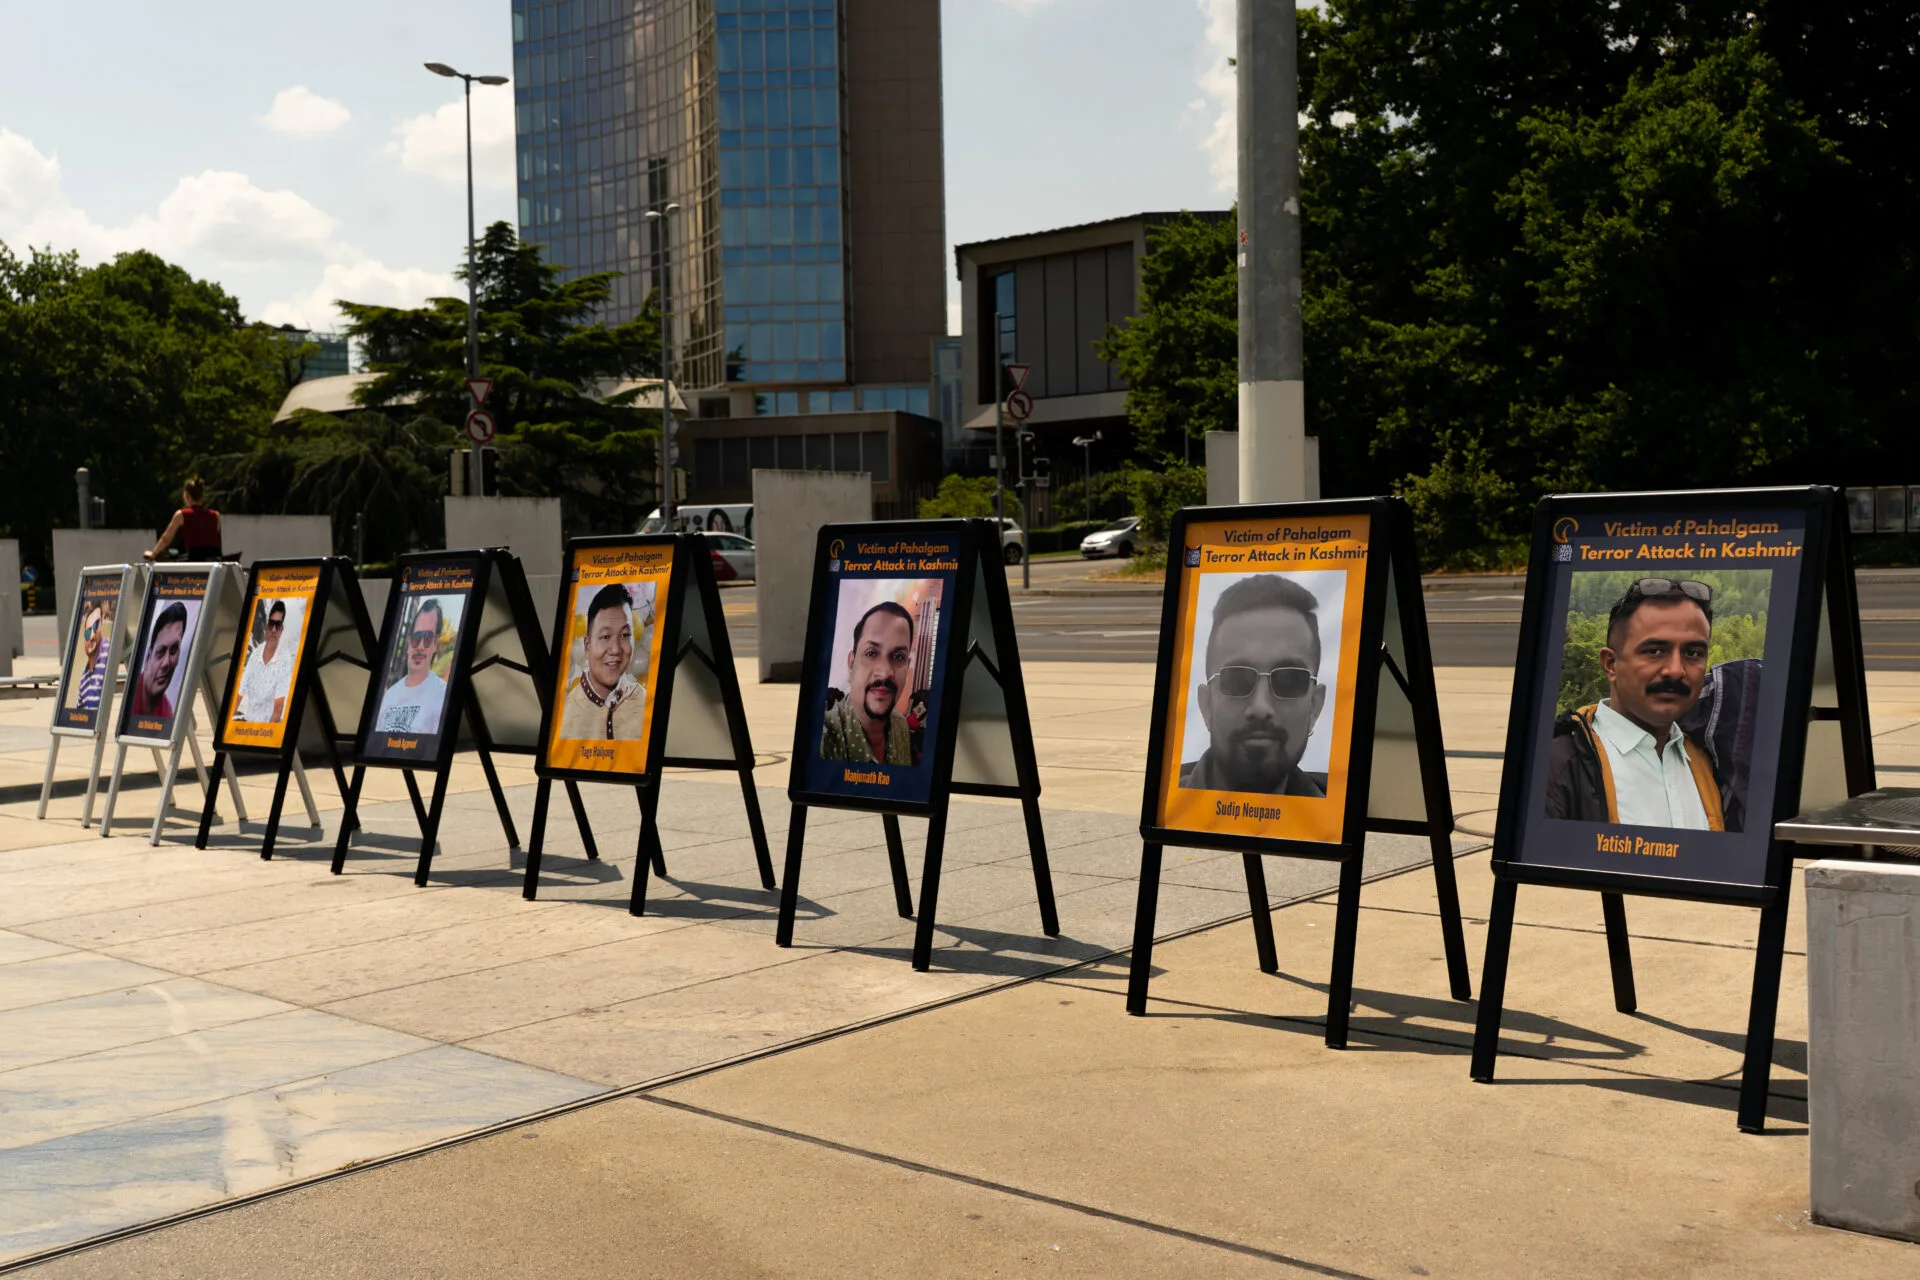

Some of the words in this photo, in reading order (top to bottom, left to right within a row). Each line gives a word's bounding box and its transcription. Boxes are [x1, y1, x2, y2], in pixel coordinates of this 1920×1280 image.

[1224, 529, 1263, 543] Victim
[1267, 527, 1280, 541] of
[1283, 526, 1351, 543] Pahalgam
[1604, 521, 1657, 537] Victim
[1662, 520, 1682, 536] of
[1685, 519, 1779, 538] Pahalgam
[857, 543, 886, 554] Victim
[888, 542, 899, 554] of
[900, 541, 949, 556] Pahalgam
[1205, 550, 1245, 563] Terror
[1247, 548, 1290, 562] Attack
[1294, 547, 1306, 560] in
[1309, 545, 1368, 560] Kashmir
[1580, 545, 1634, 560] Terror
[1636, 543, 1695, 559] Attack
[1700, 541, 1717, 558] in
[1721, 541, 1802, 558] Kashmir
[592, 554, 615, 564] Victim
[616, 552, 624, 563] of
[624, 551, 662, 563] Pahalgam
[843, 560, 872, 571] Terror
[873, 558, 904, 571] Attack
[907, 559, 916, 570] in
[581, 569, 602, 579] Terror
[604, 567, 627, 578] Attack
[630, 566, 637, 575] in
[638, 564, 670, 575] Kashmir
[451, 578, 474, 589] Kashmi
[843, 768, 877, 785] Manjunath
[877, 771, 891, 785] Rao
[1216, 800, 1240, 821] Sudip
[1242, 802, 1281, 822] Neupane
[1597, 833, 1632, 854] Yatish
[1635, 836, 1680, 858] Parmar
